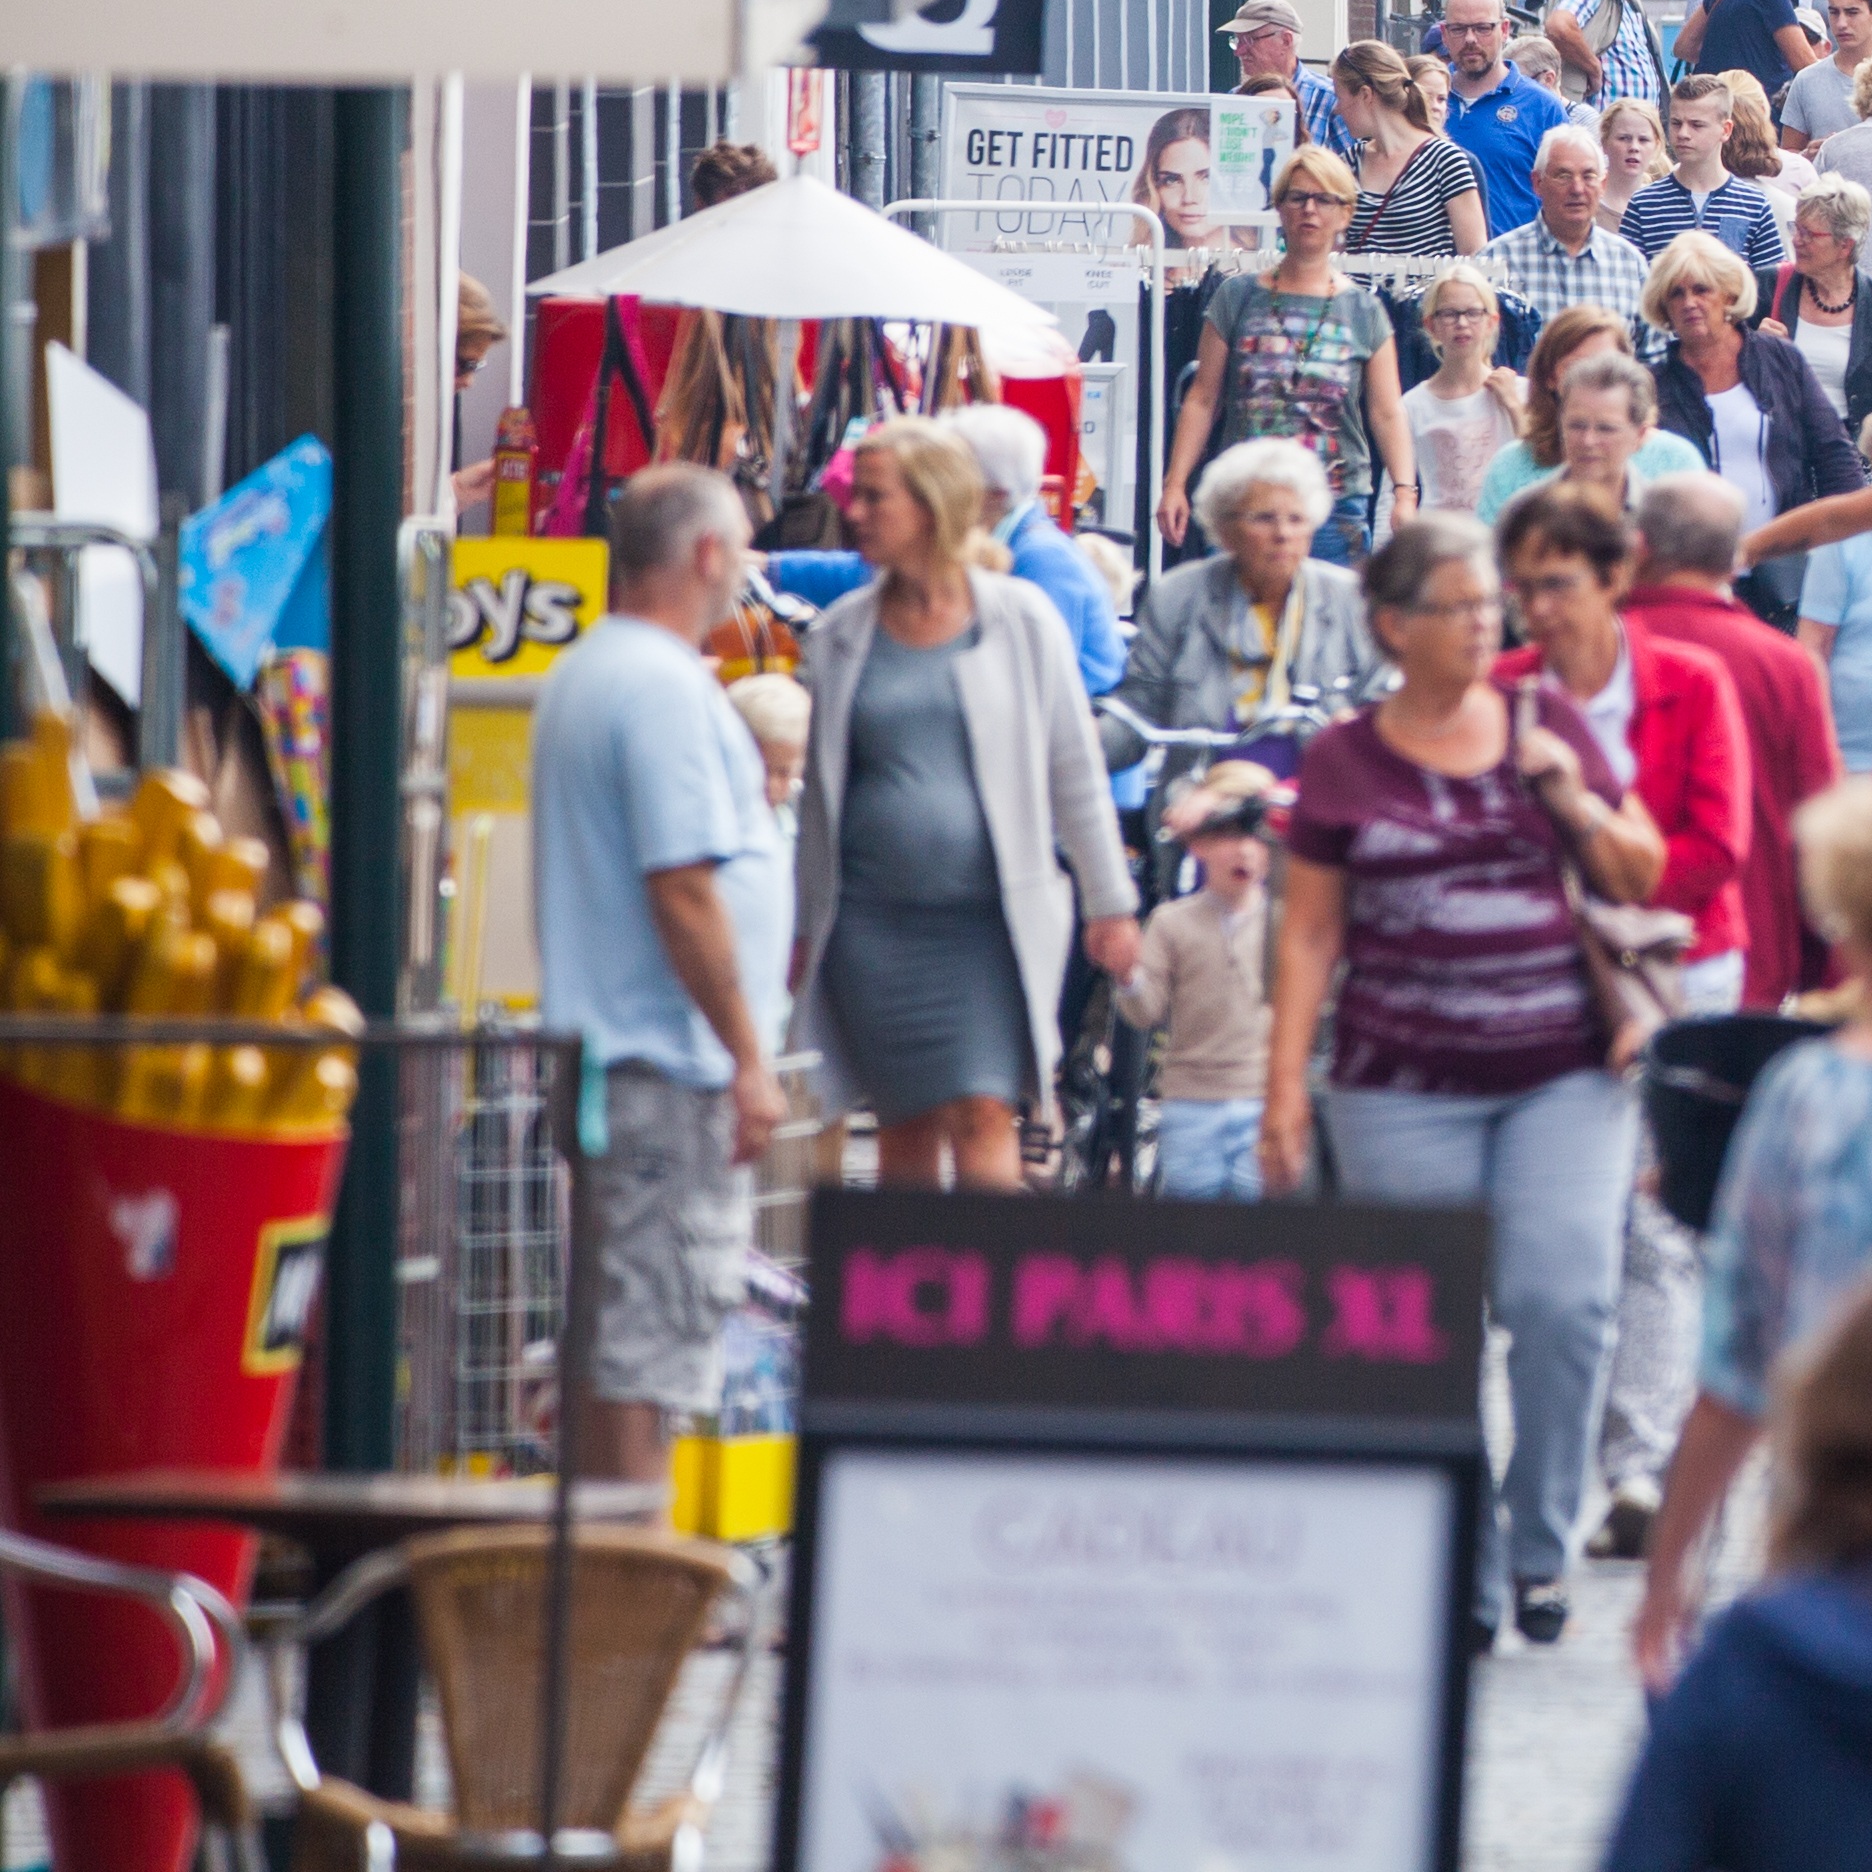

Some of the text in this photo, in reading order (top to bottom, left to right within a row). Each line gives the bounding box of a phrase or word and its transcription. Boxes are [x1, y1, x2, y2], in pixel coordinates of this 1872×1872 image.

[967, 128, 1134, 172] GET FITTED
[966, 172, 1129, 236] TODAY
[447, 567, 593, 663] oys
[840, 1245, 1448, 1366] ICI PARIS XL
